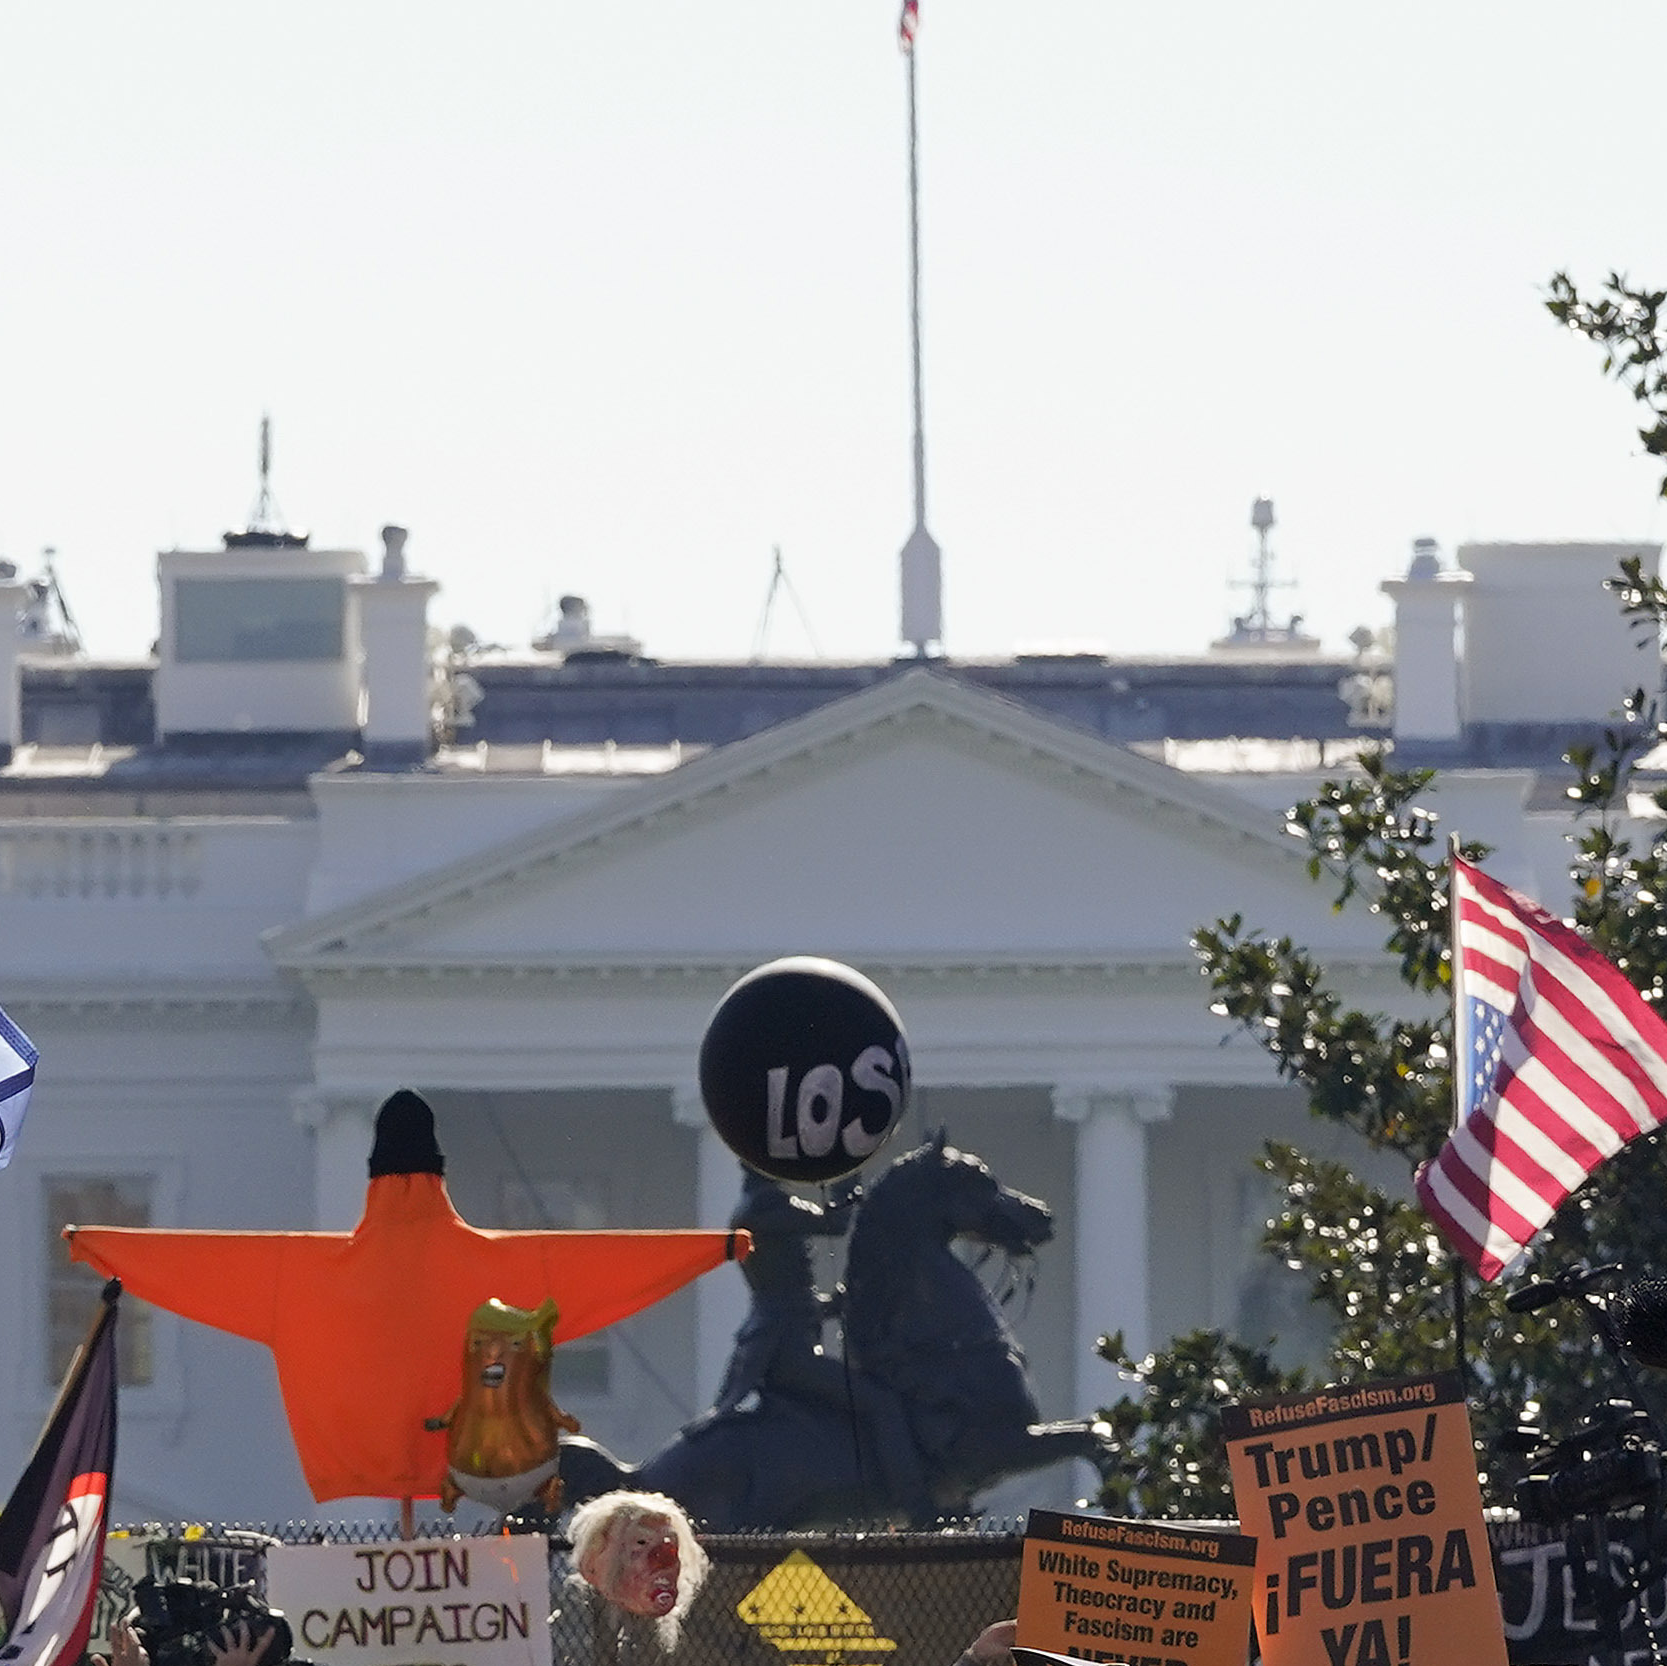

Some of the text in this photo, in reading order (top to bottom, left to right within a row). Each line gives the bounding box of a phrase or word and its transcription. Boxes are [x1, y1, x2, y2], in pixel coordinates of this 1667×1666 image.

[766, 1038, 908, 1161] LOS
[1247, 1381, 1437, 1429] RefuseFascism.org
[1243, 1412, 1438, 1489] Trump/
[1267, 1478, 1437, 1540] Pence
[1061, 1518, 1220, 1559] RefuseFascism.org
[355, 1548, 469, 1593] JOIN
[1037, 1549, 1239, 1601] White Supremacy,
[300, 1601, 530, 1649] CAMPAIGN
[1053, 1580, 1217, 1622] Theocracy and
[1063, 1610, 1199, 1648] Fascism are
